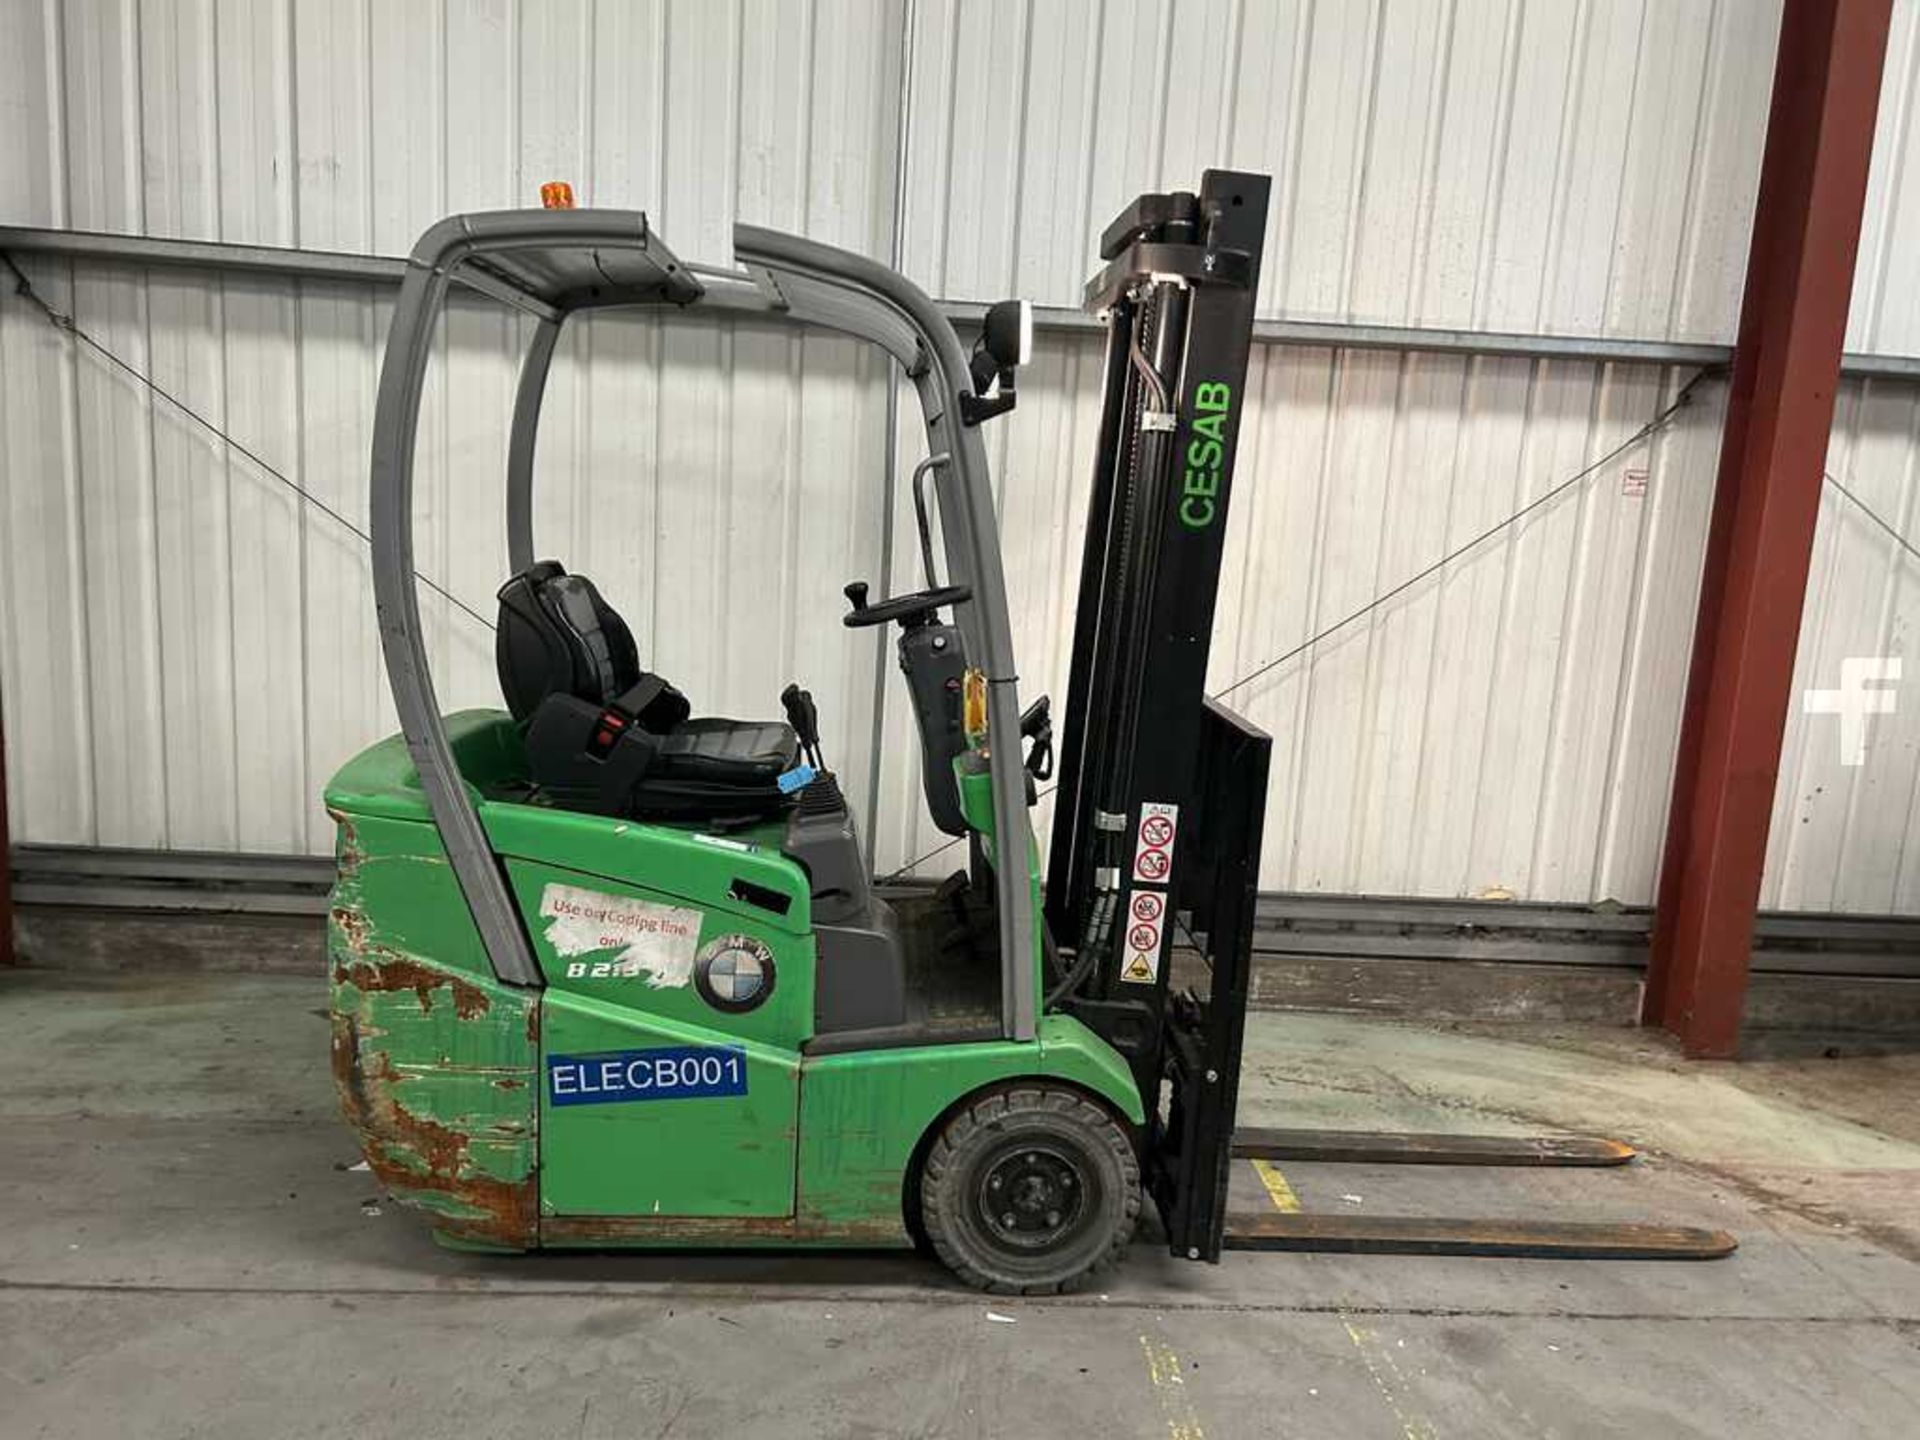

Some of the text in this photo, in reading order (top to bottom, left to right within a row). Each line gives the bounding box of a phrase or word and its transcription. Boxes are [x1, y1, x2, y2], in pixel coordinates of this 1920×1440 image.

[1179, 381, 1231, 527] CESAB
[553, 899, 581, 915] Use
[660, 919, 688, 936] line
[552, 1057, 740, 1095] ELECB001
